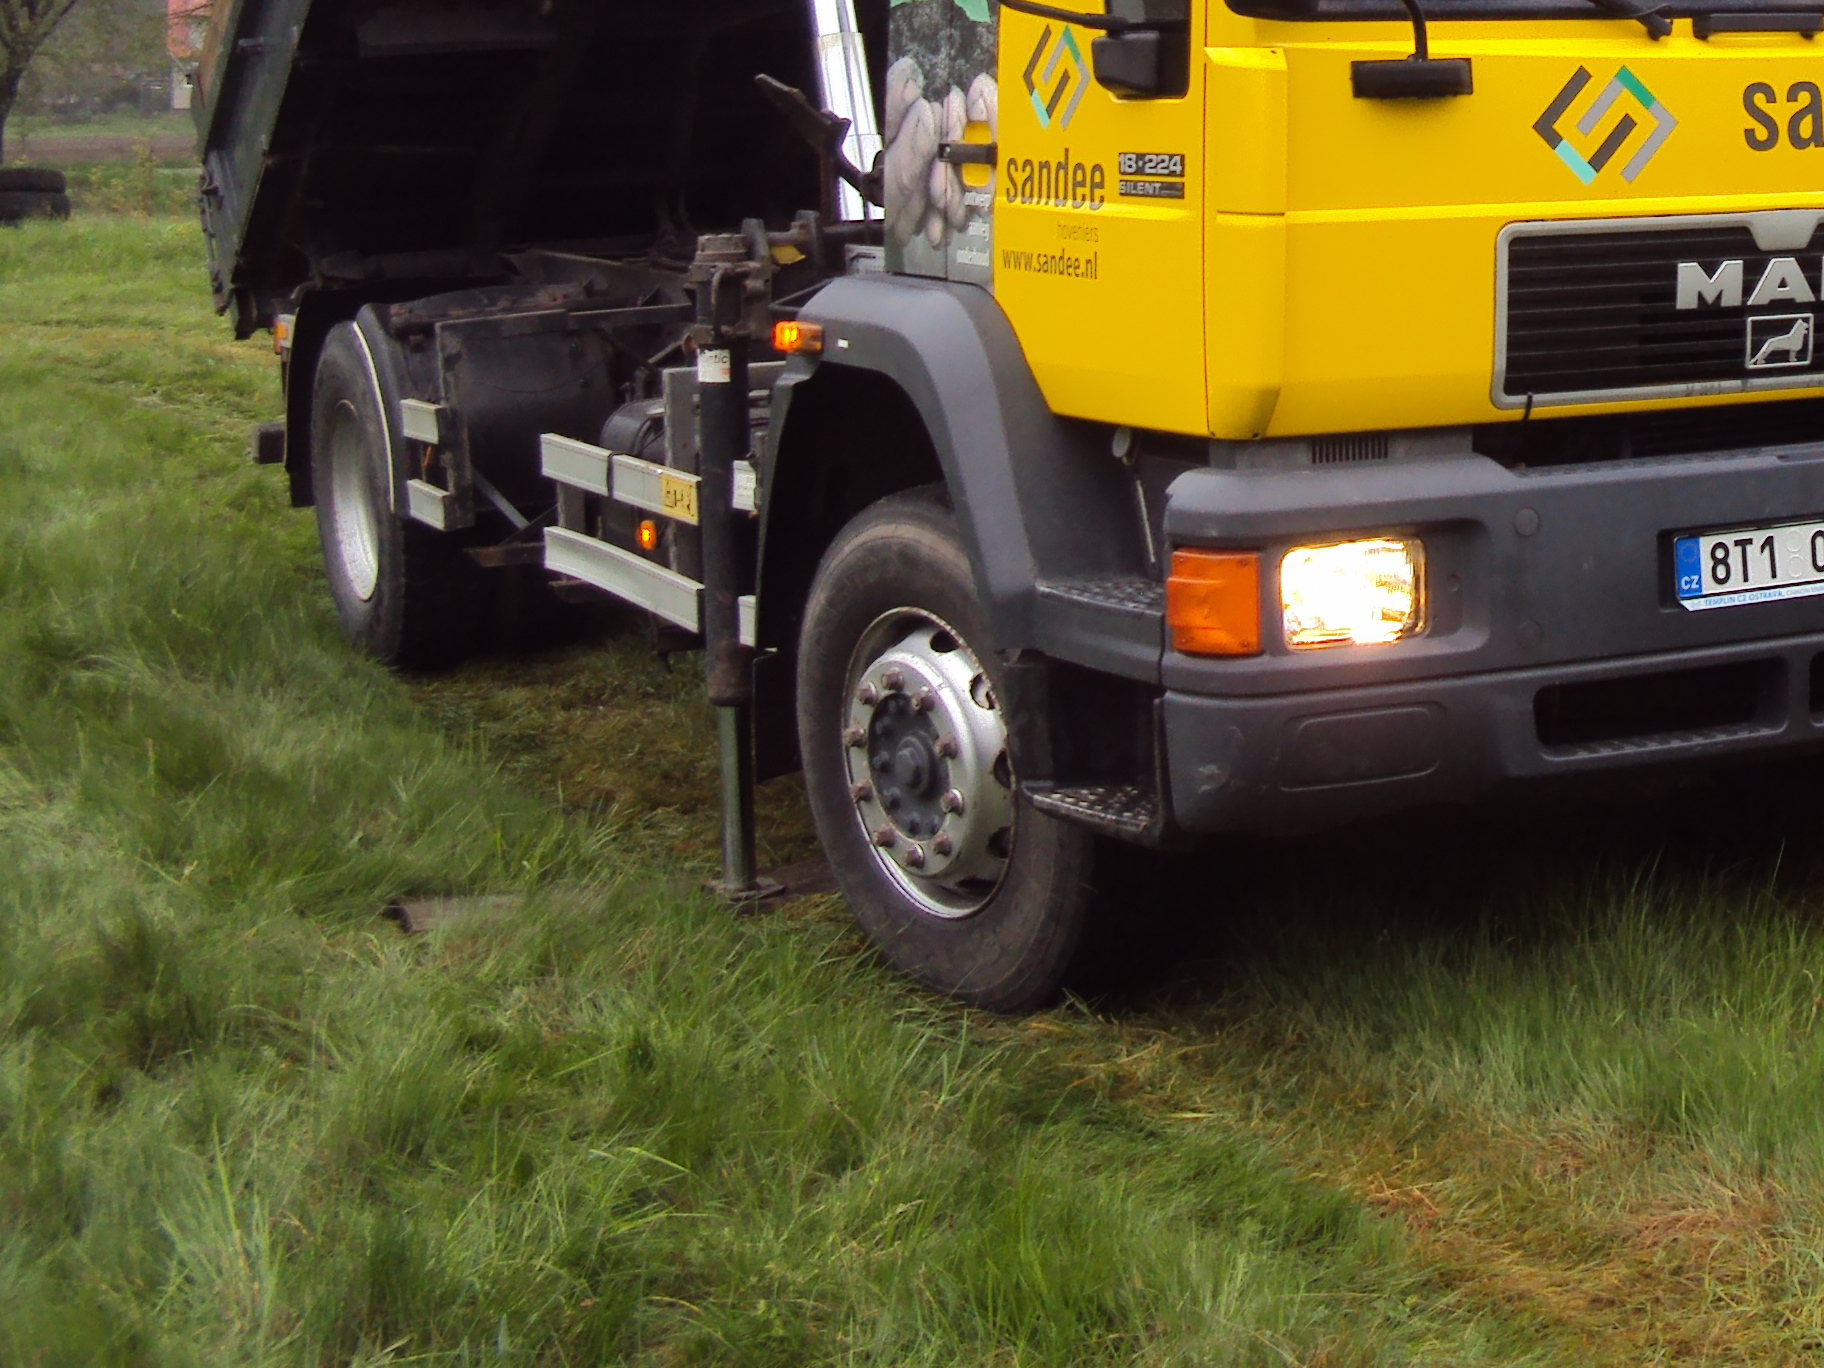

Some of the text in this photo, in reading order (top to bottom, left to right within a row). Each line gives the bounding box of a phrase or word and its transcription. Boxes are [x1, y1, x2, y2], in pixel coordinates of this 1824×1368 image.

[1006, 147, 1105, 210] sandee
[1119, 181, 1161, 195] SILENT
[1002, 248, 1098, 280] www.sandee.nl
[1710, 535, 1777, 585] 8T1
[1681, 575, 1700, 590] CZ
